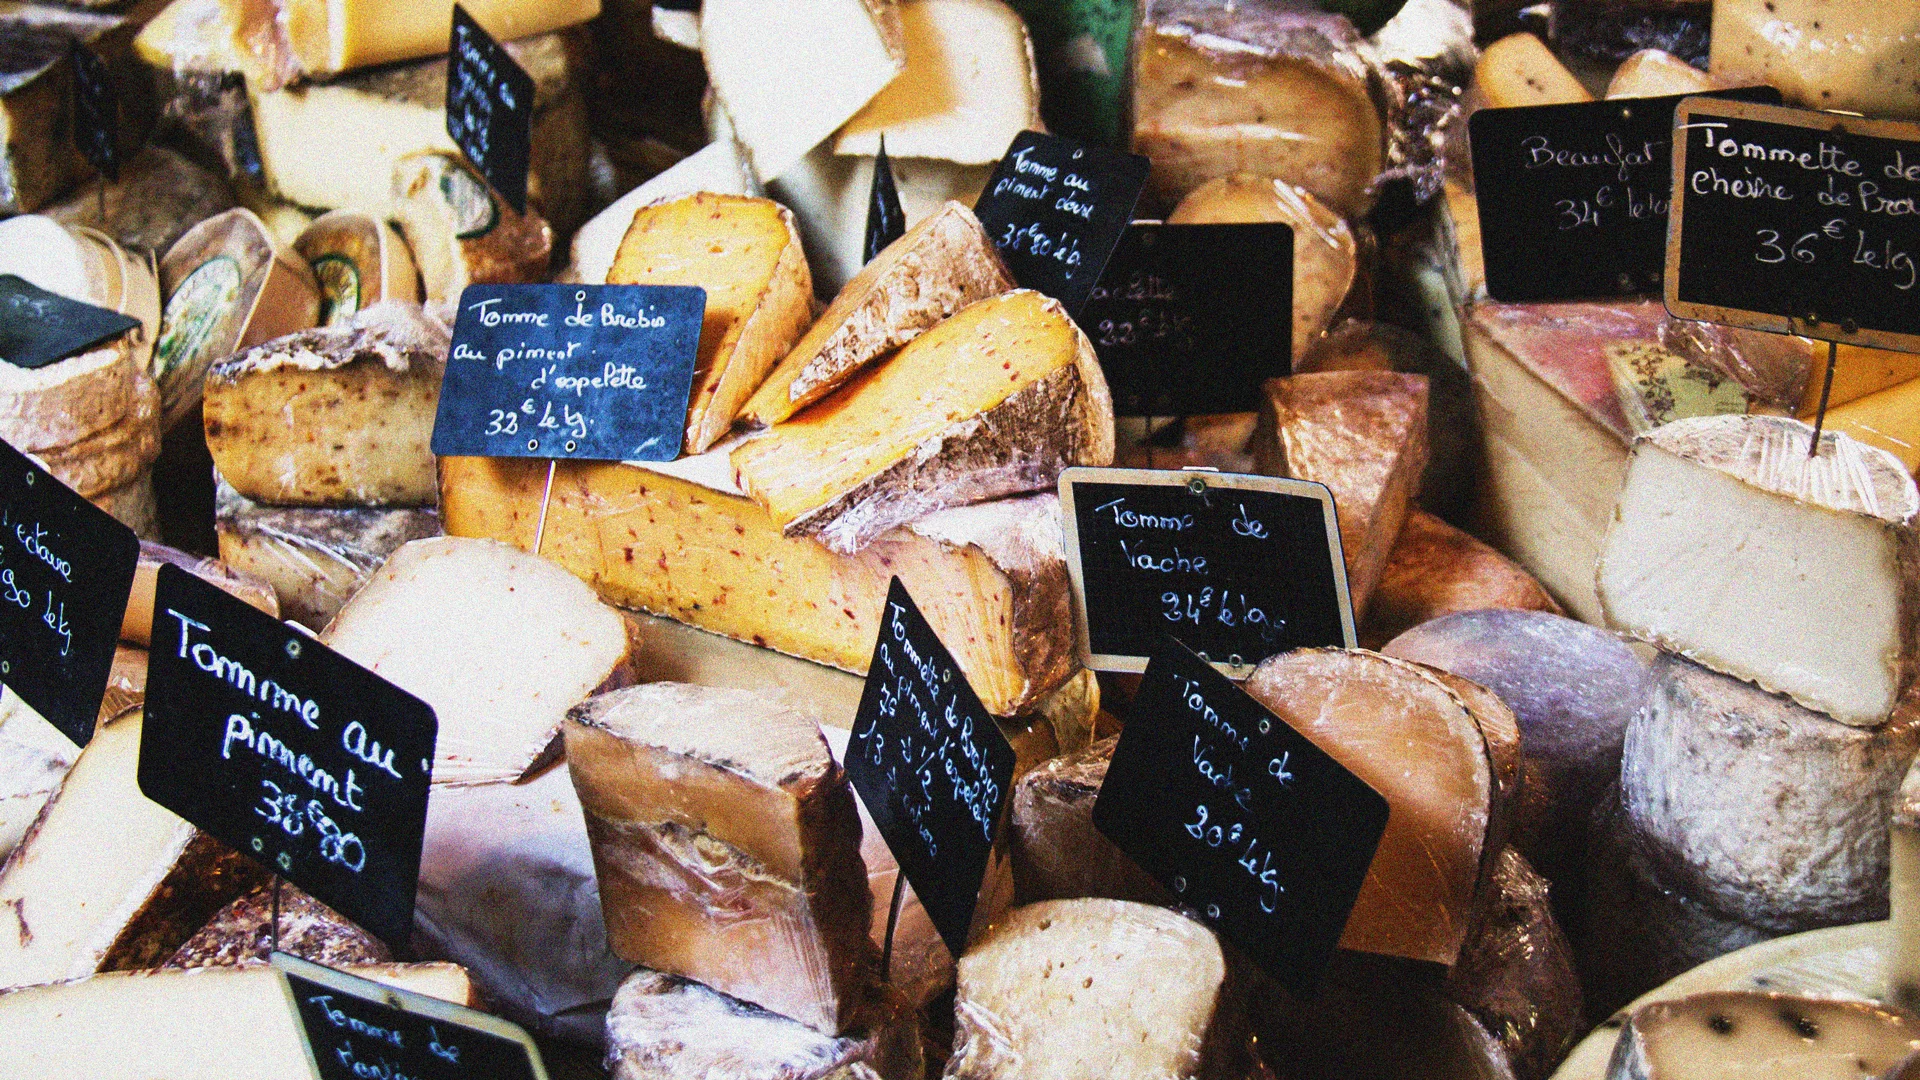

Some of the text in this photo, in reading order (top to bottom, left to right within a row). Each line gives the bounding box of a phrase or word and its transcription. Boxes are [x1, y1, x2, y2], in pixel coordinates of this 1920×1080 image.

[1012, 146, 1090, 191] Tomme au
[1677, 123, 1920, 181] Tommette de
[994, 177, 1094, 219] piment doux
[1555, 186, 1613, 230] 34€
[1818, 174, 1851, 206] de
[1755, 219, 1847, 263] 36€
[469, 298, 666, 328] Tomme de Brebis
[453, 342, 581, 370] au piment
[485, 398, 536, 435] 32€
[1095, 498, 1269, 539] Tomme de
[2, 509, 72, 583] ectaire
[1120, 540, 1208, 574] Vache
[1161, 586, 1214, 625] 24€
[167, 608, 402, 779] Tomme au
[881, 643, 898, 678] au
[898, 676, 938, 740] piment
[945, 694, 959, 728] de
[1173, 674, 1296, 786] Tomme de
[222, 711, 363, 811] piment
[309, 996, 404, 1047] Tomme
[429, 1025, 460, 1063] de
